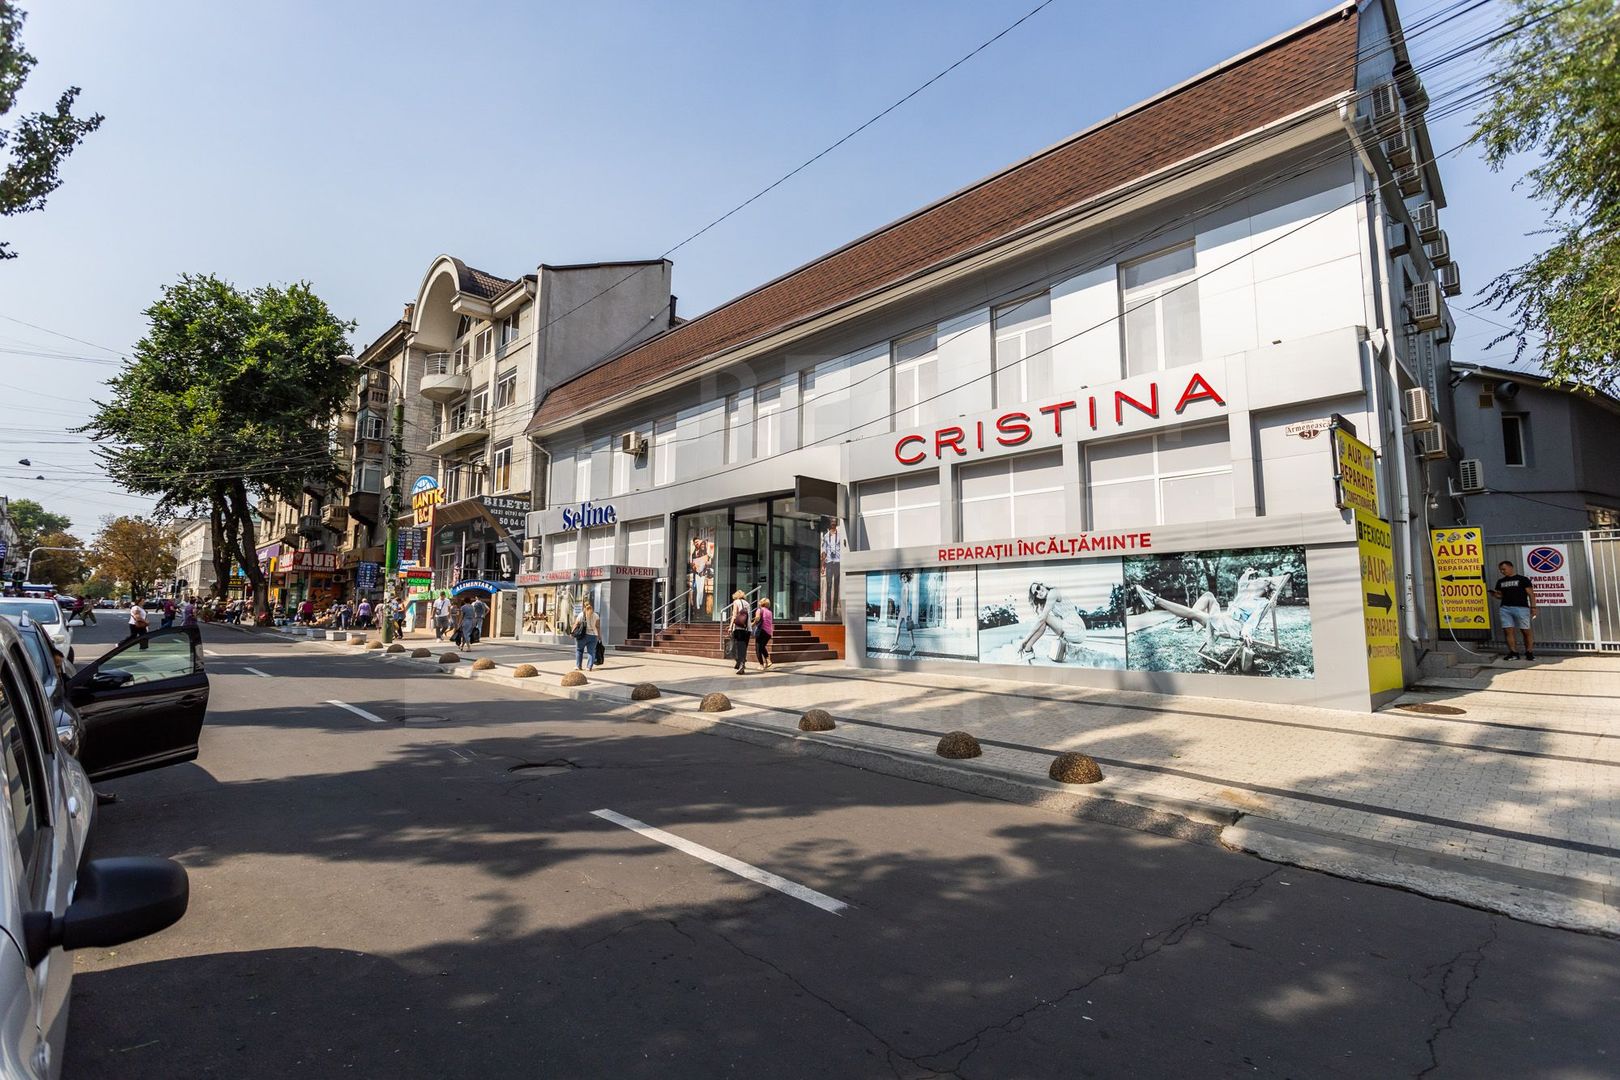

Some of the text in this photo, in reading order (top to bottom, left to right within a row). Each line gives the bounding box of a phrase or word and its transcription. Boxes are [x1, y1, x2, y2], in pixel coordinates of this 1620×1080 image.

[894, 372, 1226, 465] CRISTINA
[1303, 429, 1316, 439] 51
[1347, 443, 1363, 468] AUR
[483, 496, 531, 510] BILETE
[562, 501, 618, 532] Seline
[938, 533, 1152, 561] REPARAȚII ÎNCĂLȚĂMINTE
[1437, 543, 1478, 557] AUR
[301, 553, 335, 567] AUR
[615, 567, 654, 577] DRAPERII
[1367, 555, 1388, 585] AUR
[1440, 584, 1483, 597] ЗОЛОТО
